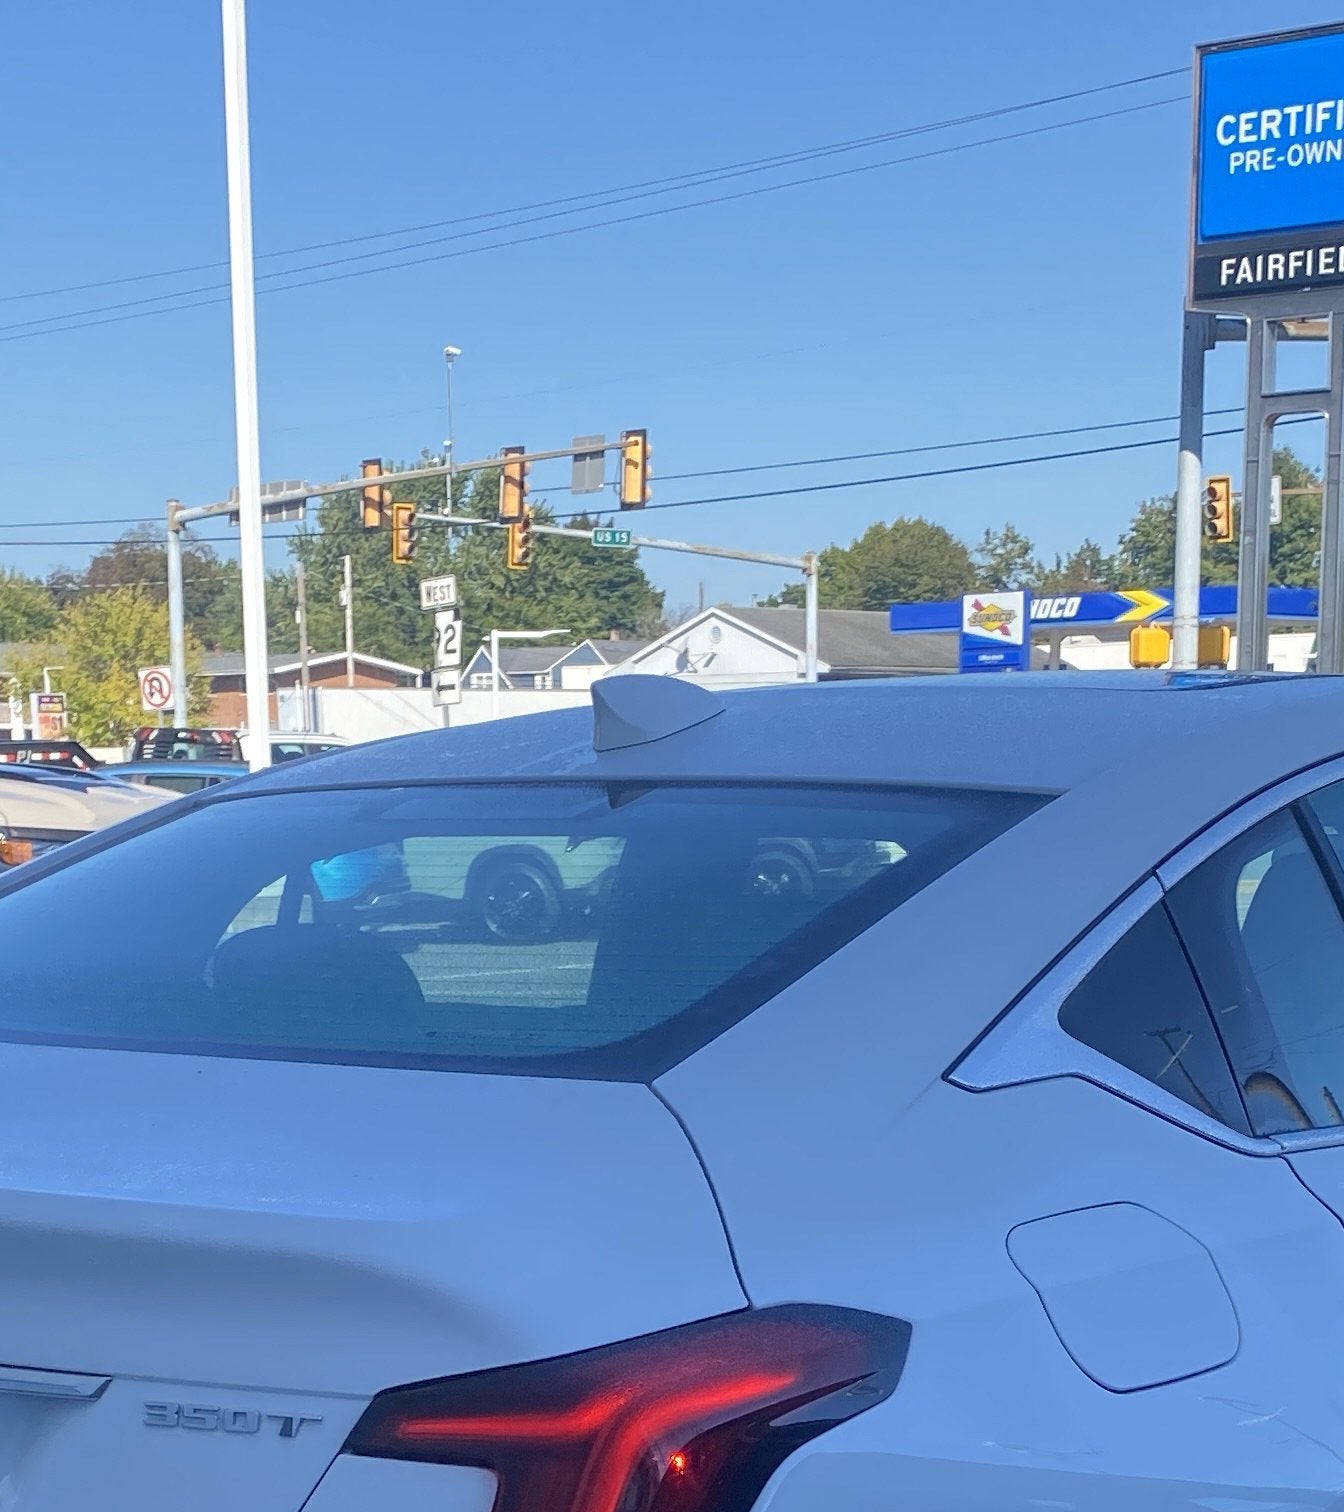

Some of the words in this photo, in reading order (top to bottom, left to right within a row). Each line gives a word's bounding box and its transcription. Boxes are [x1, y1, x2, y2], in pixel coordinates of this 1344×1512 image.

[596, 531, 612, 542] US
[615, 532, 627, 543] 15
[424, 584, 451, 602] WEST
[143, 1401, 324, 1438] 350T
